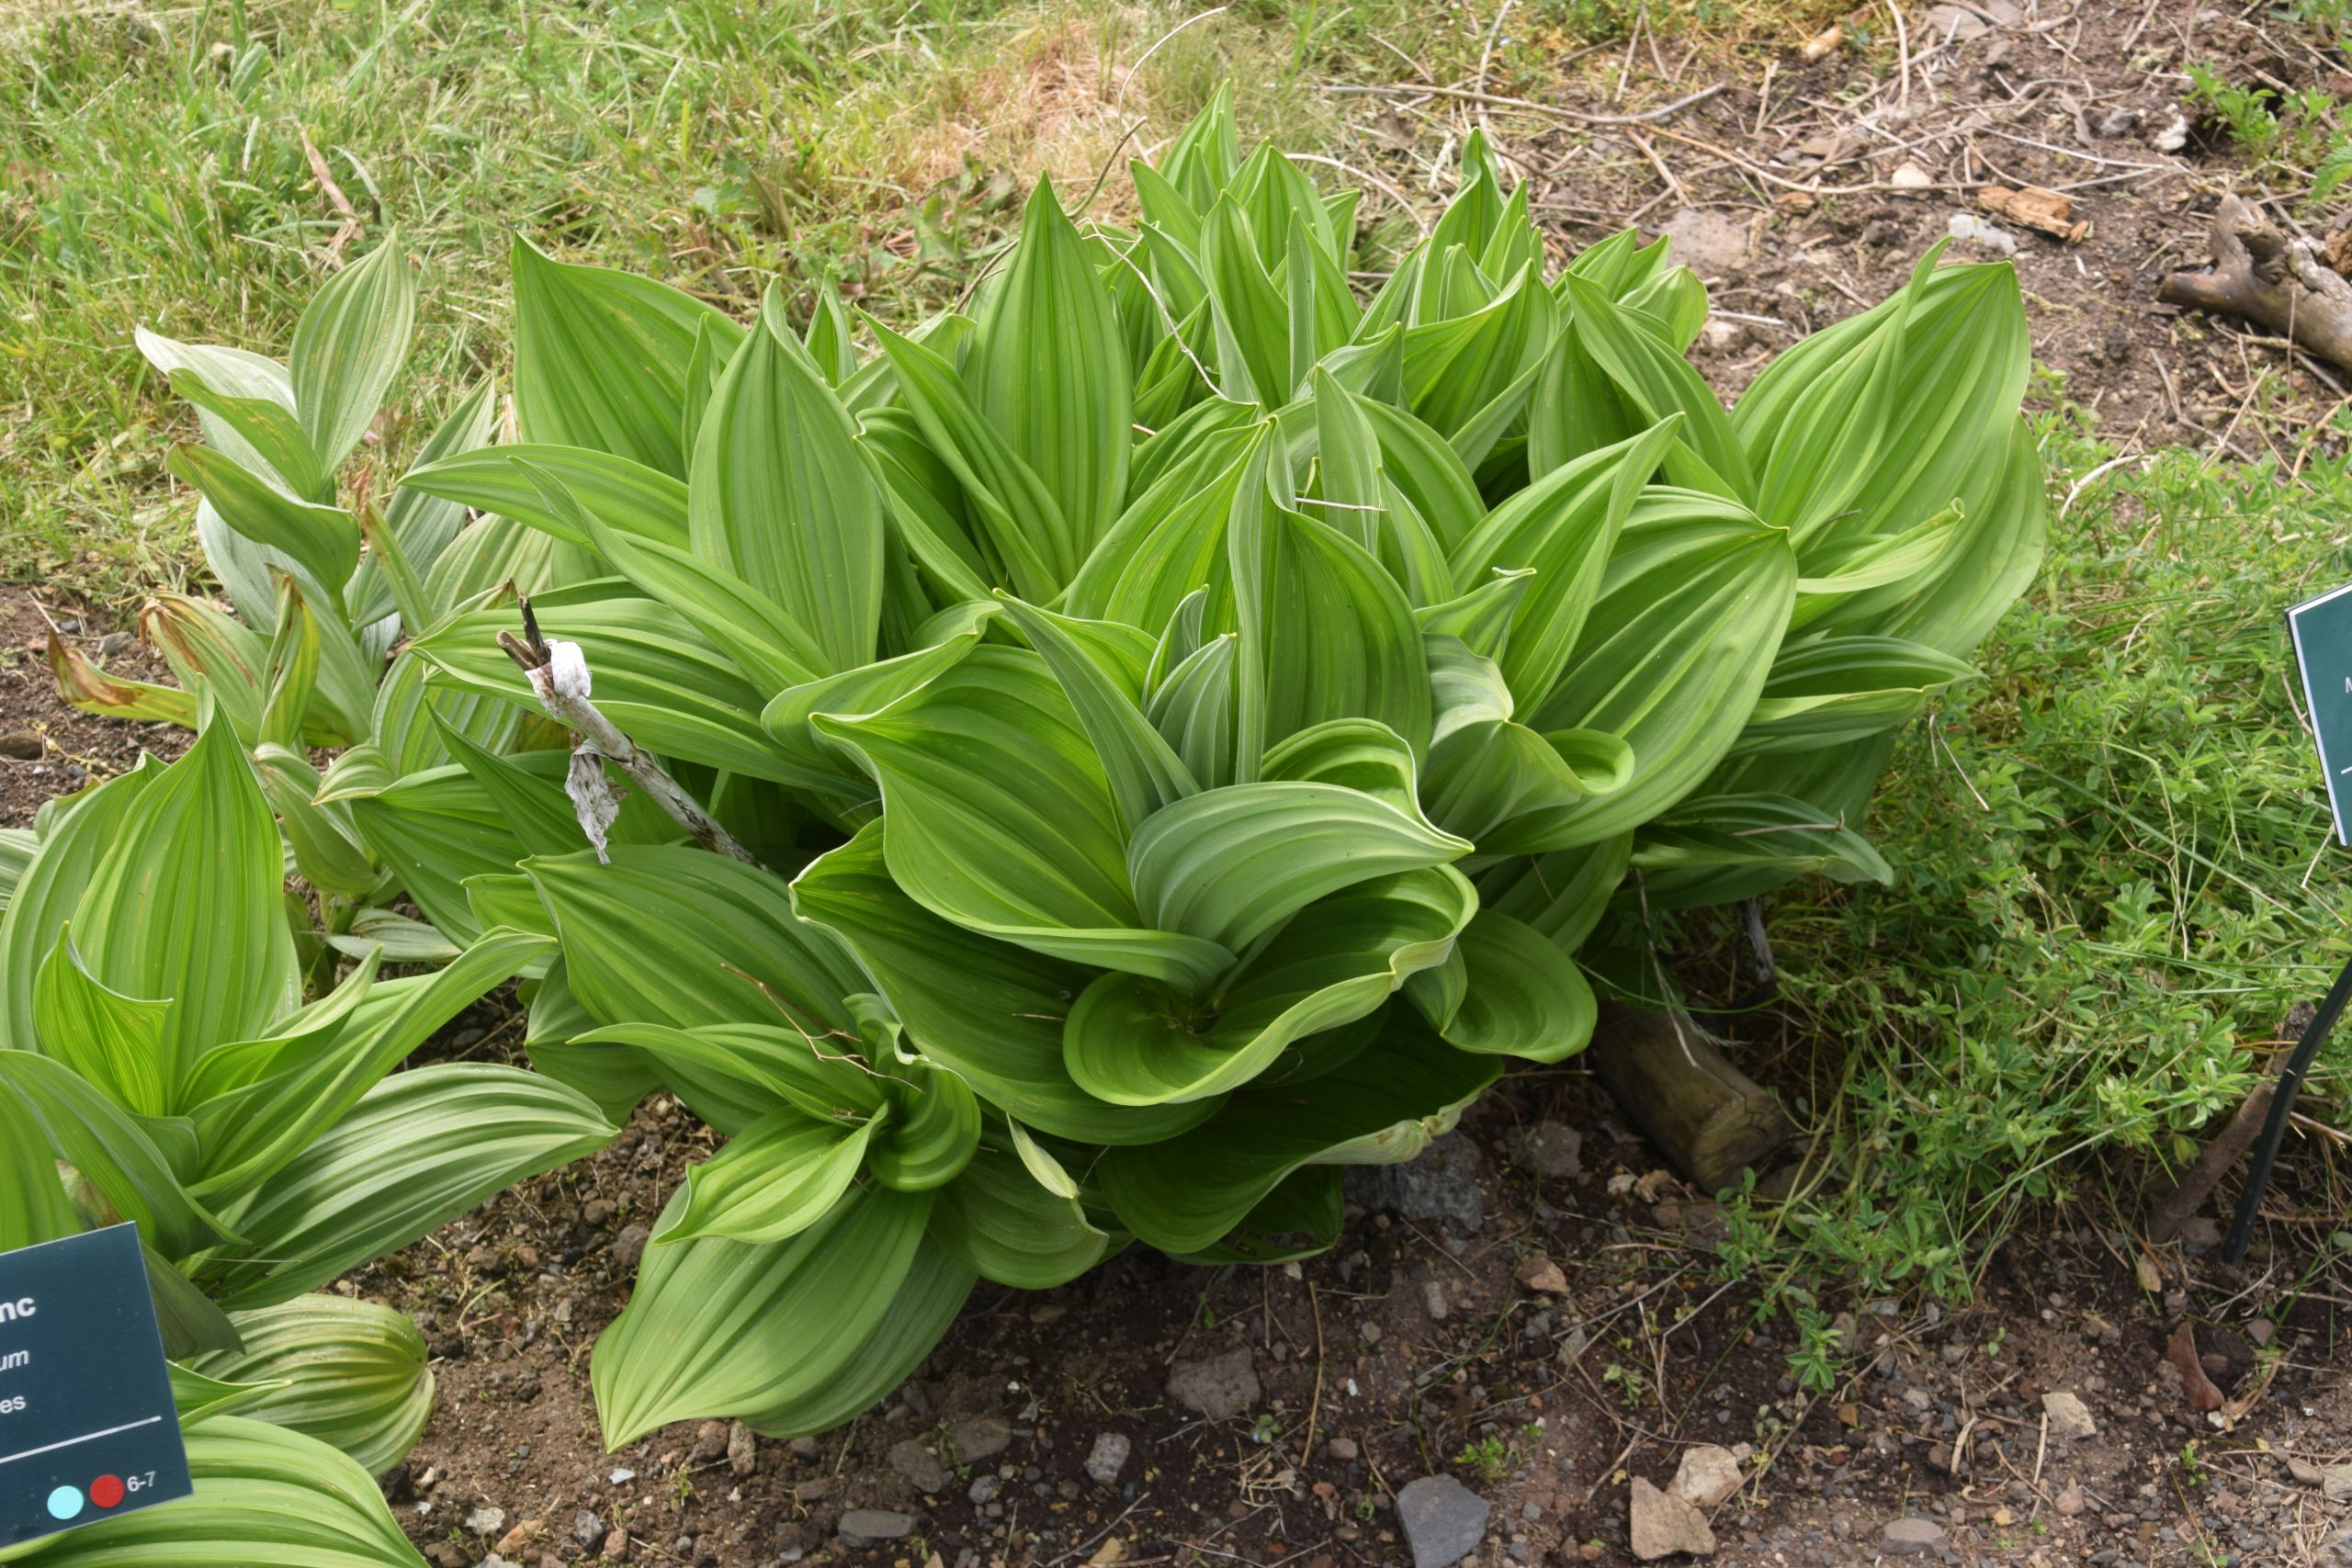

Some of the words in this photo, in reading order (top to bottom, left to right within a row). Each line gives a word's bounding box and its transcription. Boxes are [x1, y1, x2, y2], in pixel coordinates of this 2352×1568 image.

[0, 1297, 36, 1323] nc
[0, 1396, 27, 1414] es
[127, 1471, 156, 1492] 6-7
